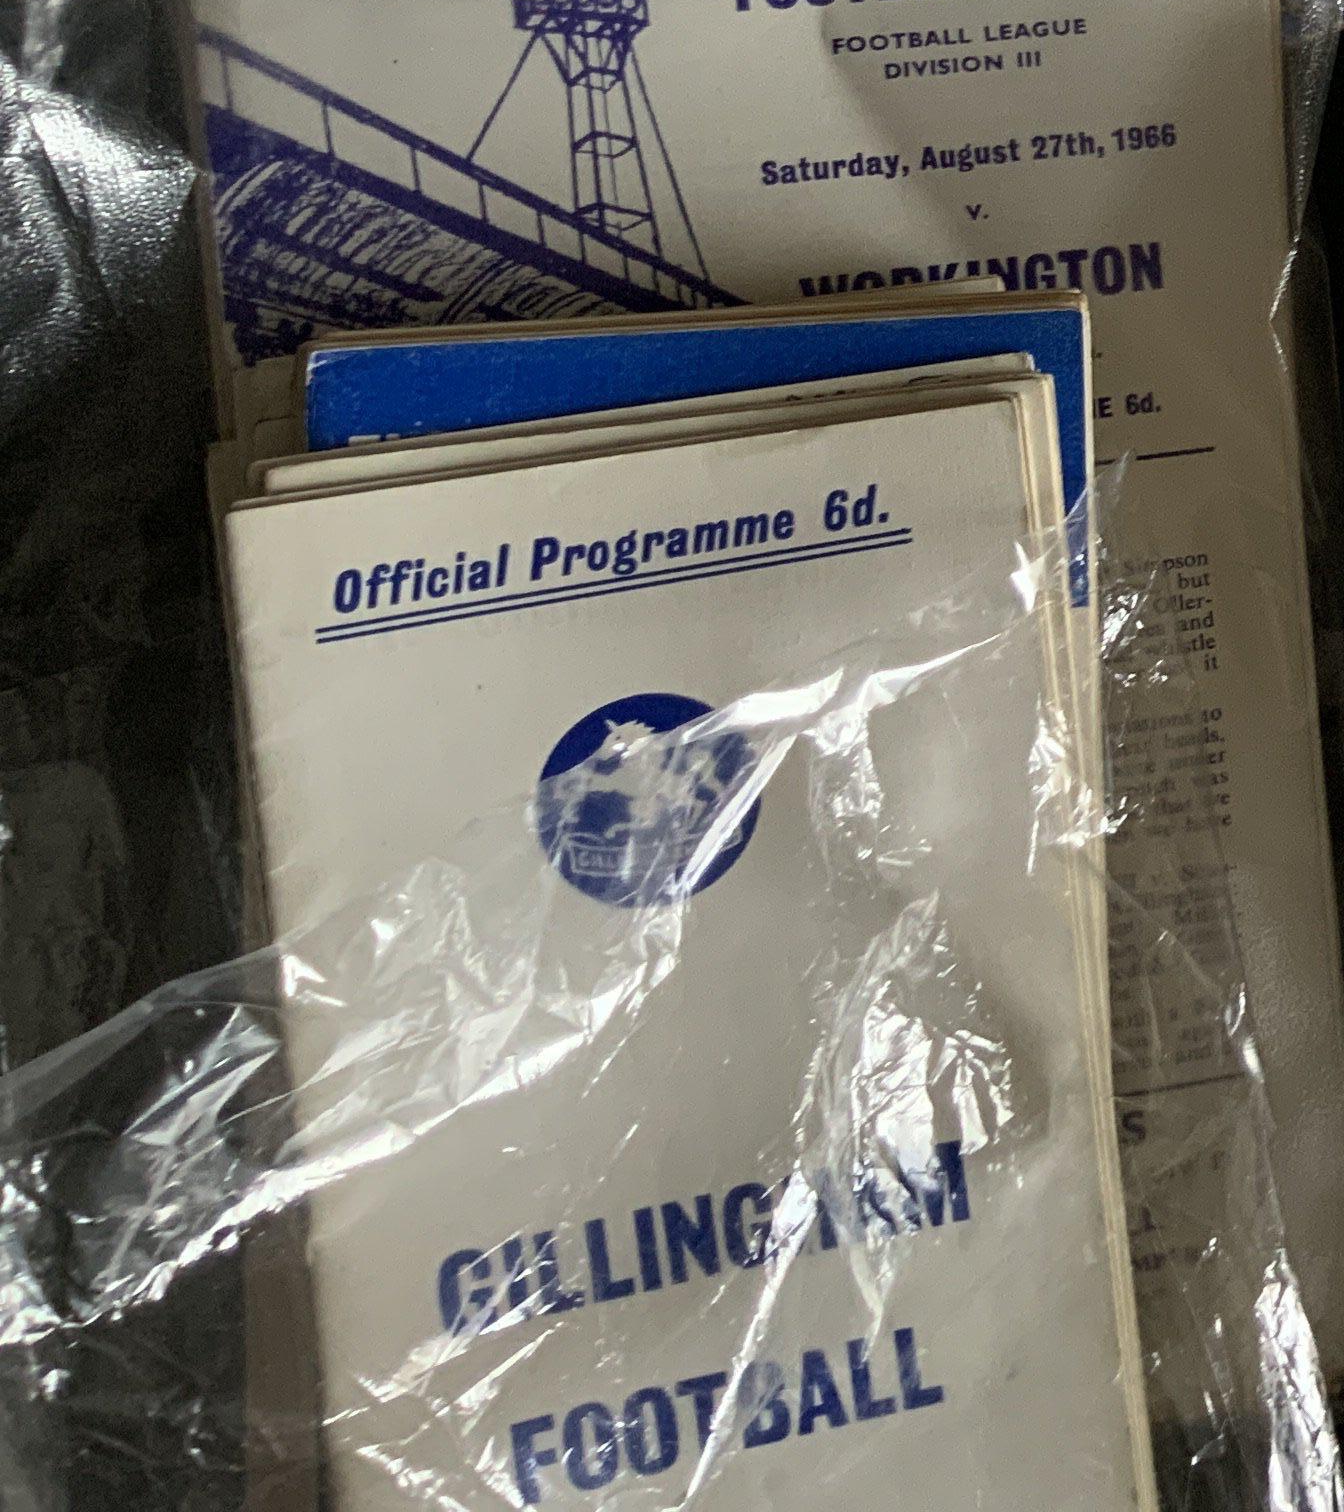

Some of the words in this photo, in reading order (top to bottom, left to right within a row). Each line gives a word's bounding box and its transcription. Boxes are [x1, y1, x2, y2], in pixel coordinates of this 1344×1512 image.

[832, 27, 972, 55] FOOTBALL
[984, 17, 1088, 41] LEAGUE
[884, 54, 1004, 80] DIVISION
[760, 150, 911, 187] Saturday,
[920, 137, 1021, 175] August
[1031, 130, 1106, 160] 27th,
[1110, 122, 1177, 151] 1966
[1126, 393, 1161, 416] 6d.
[333, 543, 511, 616] Official
[529, 502, 796, 585] Programme
[823, 484, 891, 534] 6d.
[510, 1326, 945, 1506] FOOTBALL
